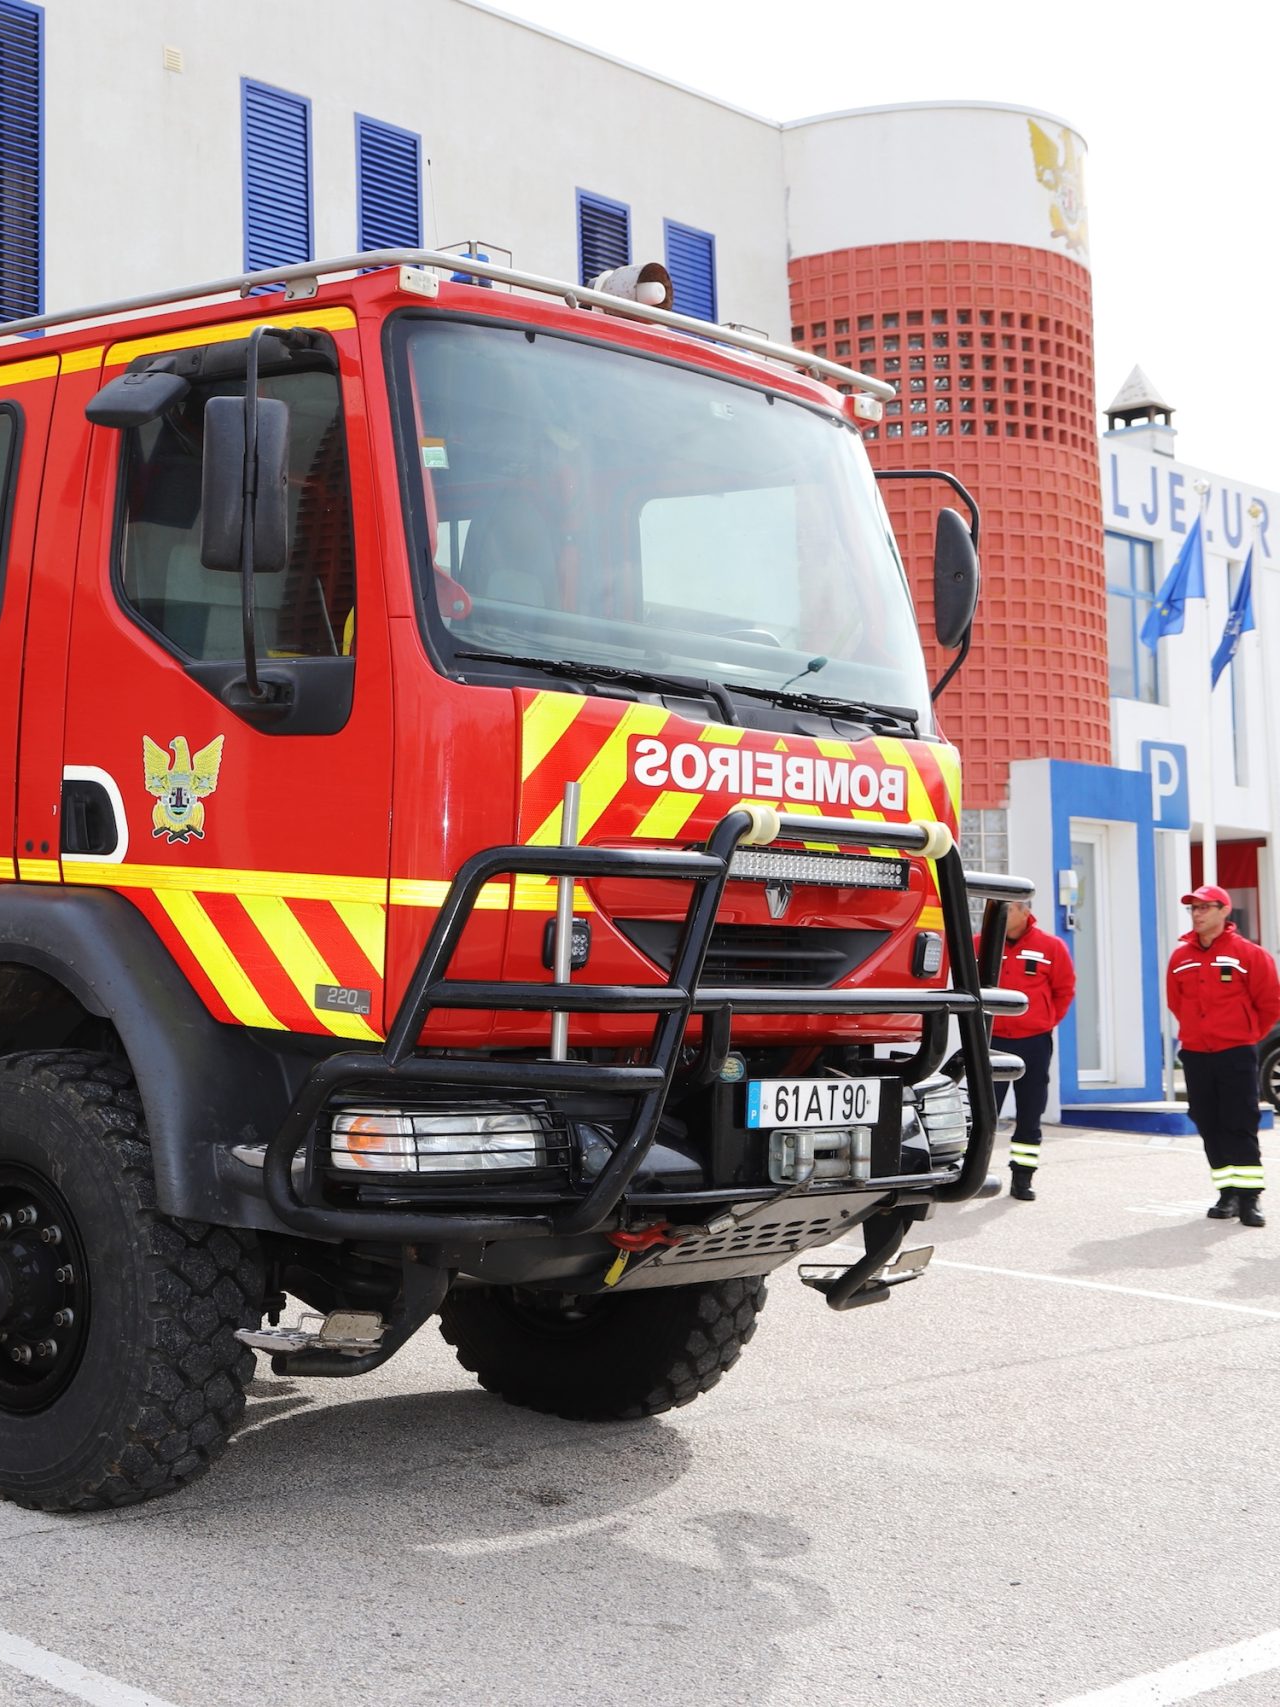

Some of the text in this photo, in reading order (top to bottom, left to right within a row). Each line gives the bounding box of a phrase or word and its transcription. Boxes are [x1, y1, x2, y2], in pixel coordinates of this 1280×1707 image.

[1150, 748, 1180, 821] P
[327, 987, 358, 1005] 220
[751, 1109, 757, 1120] P
[775, 1084, 866, 1122] 61AT90
